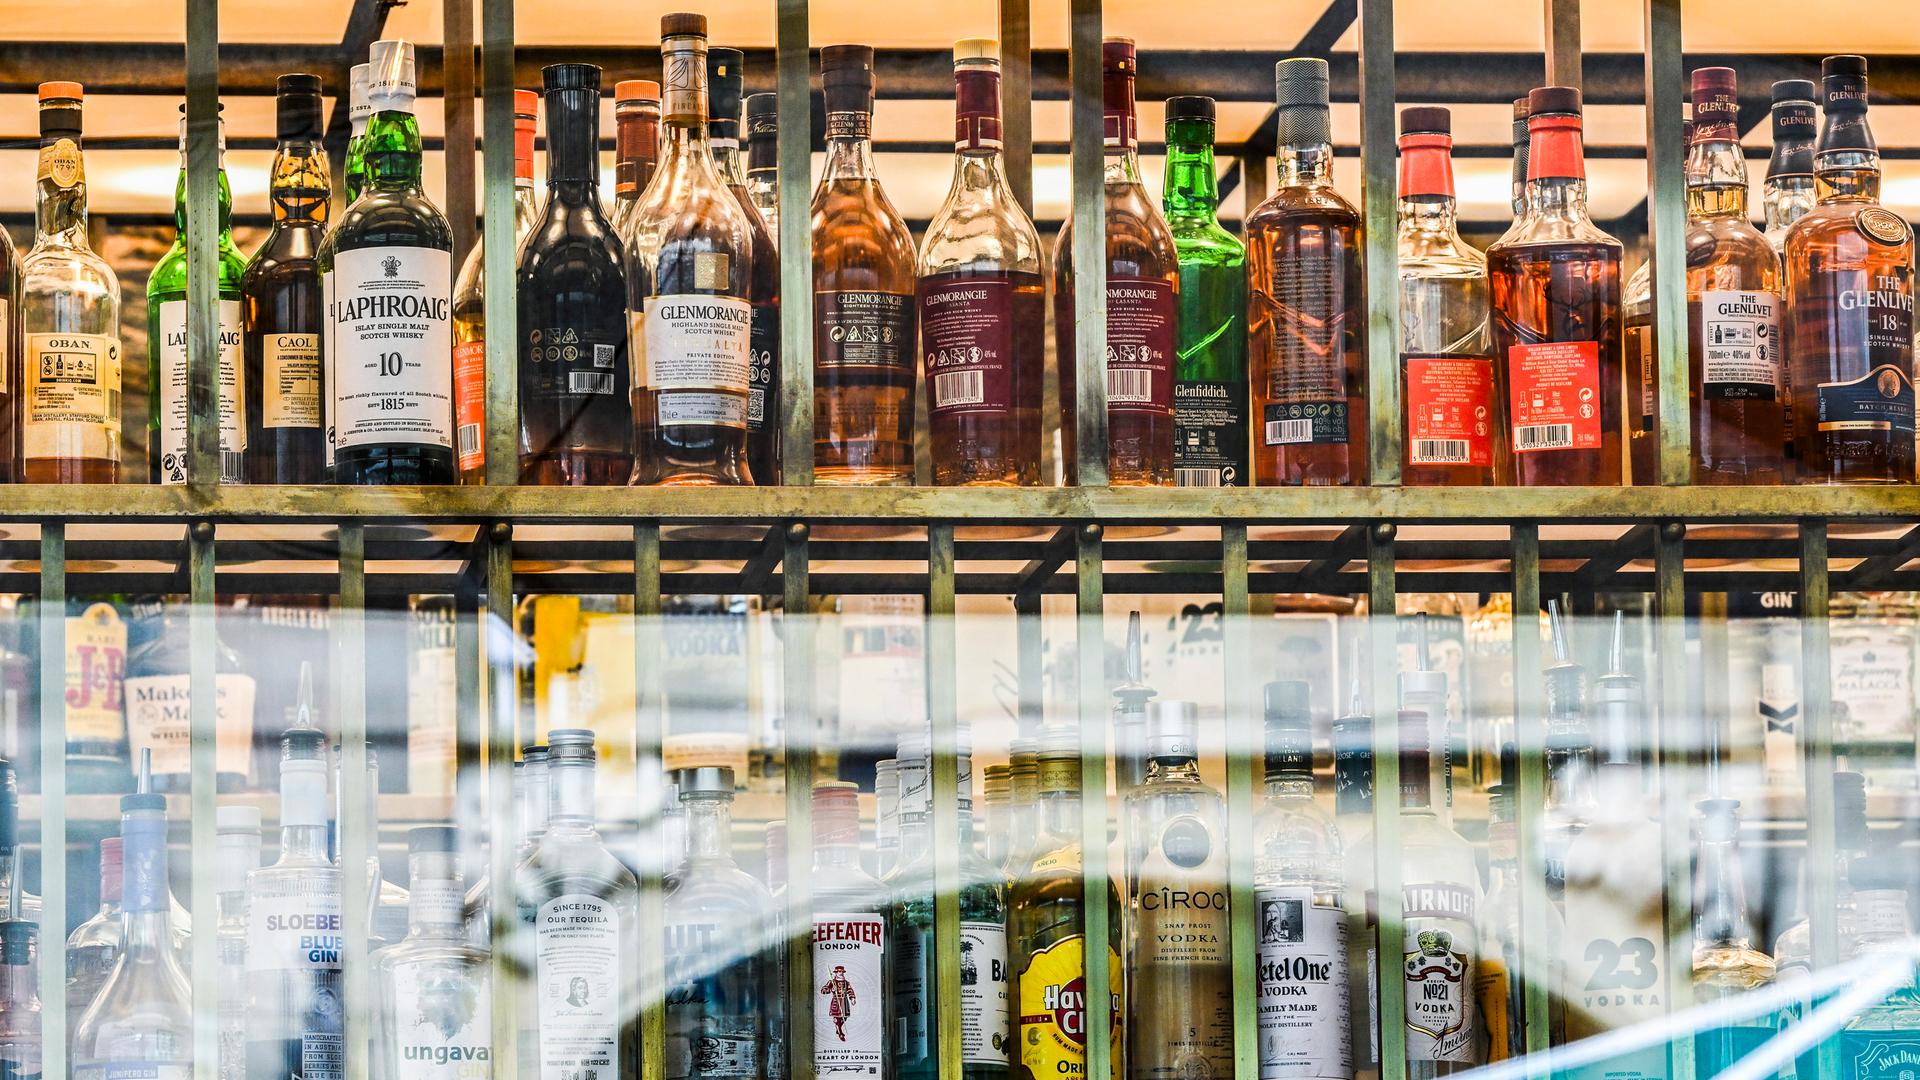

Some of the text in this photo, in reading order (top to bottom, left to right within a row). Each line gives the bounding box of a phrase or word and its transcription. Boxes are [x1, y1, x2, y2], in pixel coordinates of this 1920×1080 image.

[1876, 275, 1900, 290] THE
[838, 293, 903, 306] GLENMORANGIE
[925, 290, 988, 306] GLENMORANGIE
[1106, 288, 1158, 300] NMORANGIE
[1740, 295, 1756, 304] THE
[338, 295, 448, 324] LAPHROAIG
[660, 306, 748, 325] GLENMORANGIE
[1718, 303, 1773, 317] GLENLIVET
[355, 324, 375, 332] ISLAY
[410, 323, 430, 331] MALT
[710, 323, 731, 331] SINGLE
[1881, 314, 1897, 330] 18
[168, 332, 240, 347] LAAIG
[393, 332, 424, 340] WHISKY
[714, 329, 736, 337] WHISKY
[49, 339, 90, 349] OBAN
[277, 336, 312, 348] CAOL
[379, 351, 403, 377] 10
[1175, 384, 1228, 398] Glenfiddich.
[380, 398, 405, 411] 1815
[1760, 592, 1794, 609] GIN
[136, 687, 227, 703] Makes
[1036, 857, 1058, 868] AÑEJO
[1142, 886, 1225, 911] CÎROC
[553, 903, 602, 913] SINCE 1795
[1158, 934, 1219, 943] VODKA
[308, 949, 338, 963] GIN
[1292, 956, 1330, 982] One
[1583, 936, 1659, 992] 23
[1265, 985, 1308, 997] VODKA
[1289, 1003, 1318, 1012] MADE
[1415, 1001, 1455, 1014] VODKA
[1584, 993, 1661, 1009] VODKA
[1189, 1027, 1197, 1038] 5
[1052, 1032, 1078, 1054] RUM MADE
[403, 1045, 489, 1066] ungava
[1878, 1056, 1899, 1072] JACK
